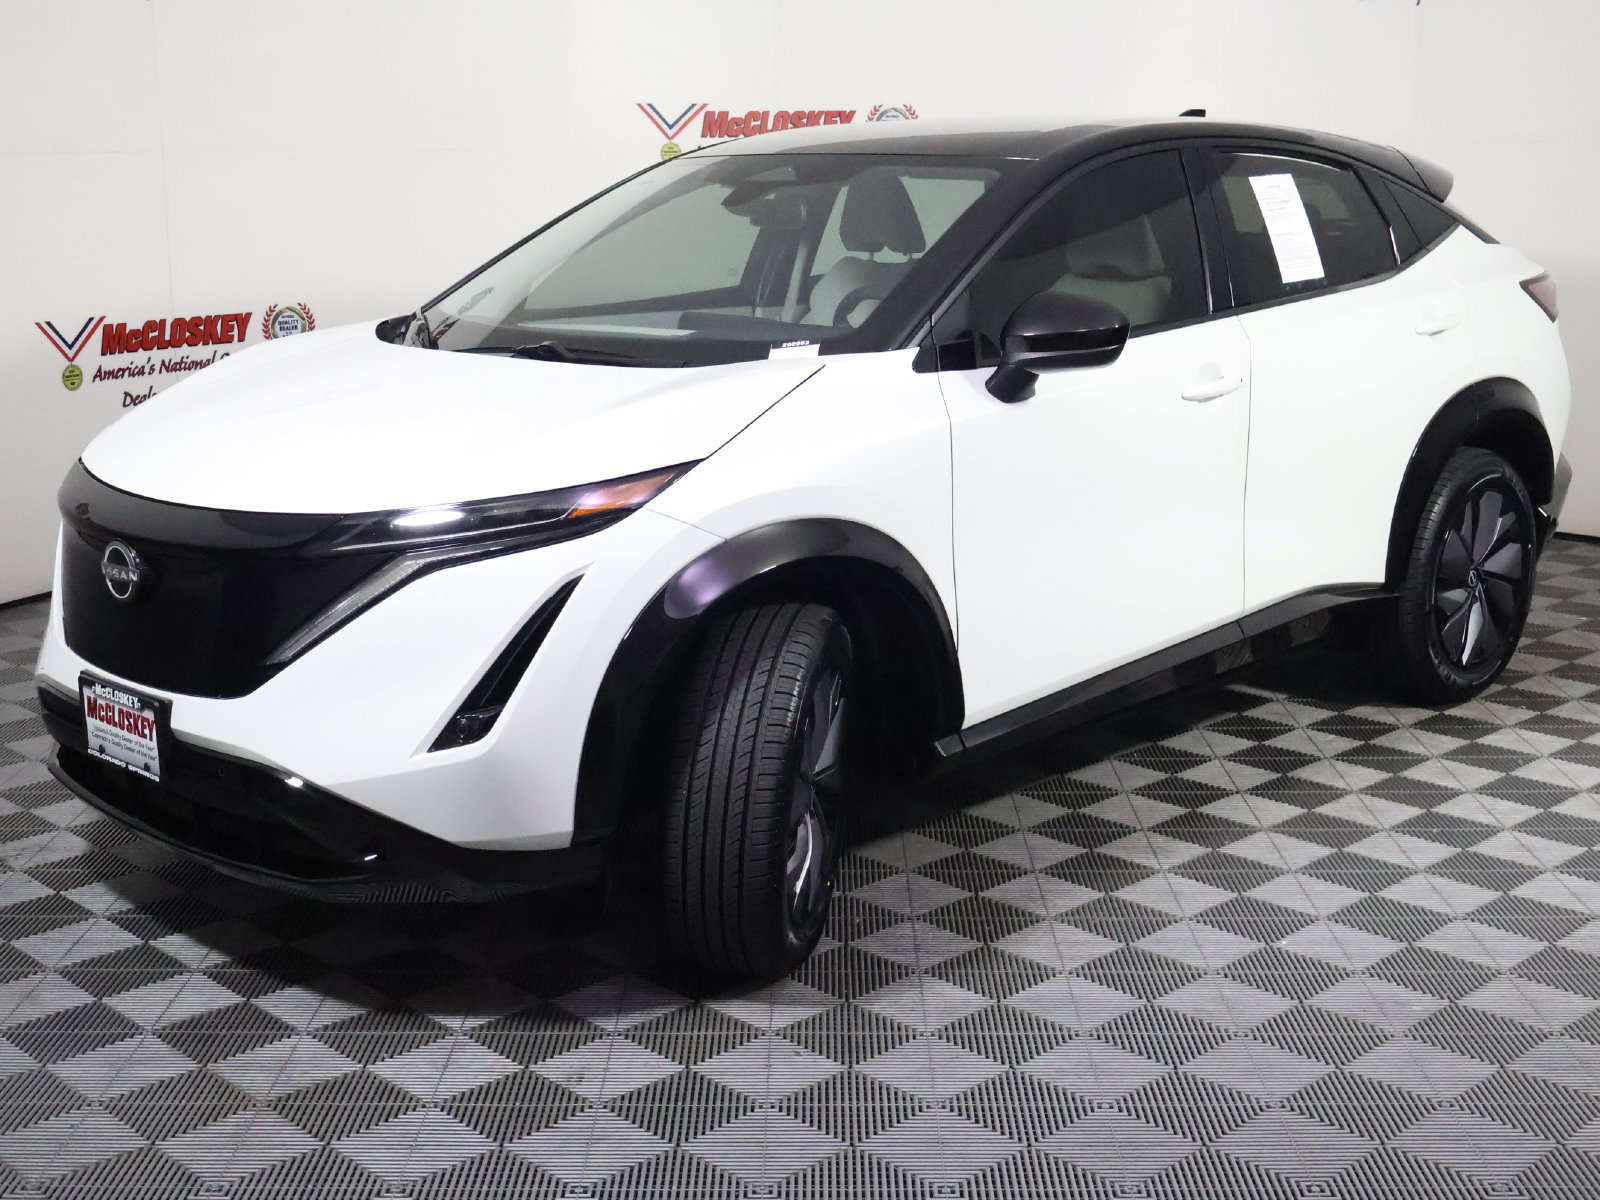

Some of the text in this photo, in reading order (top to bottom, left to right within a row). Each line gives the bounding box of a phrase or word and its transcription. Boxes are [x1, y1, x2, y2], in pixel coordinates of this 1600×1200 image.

[101, 312, 252, 356] McCLOSKEY
[92, 357, 156, 383] America's
[122, 385, 158, 408] Deal
[95, 683, 138, 708] McCLOSKEY
[87, 695, 156, 742] McCLOSKEY
[87, 748, 160, 782] COLORADO SPRINGS
